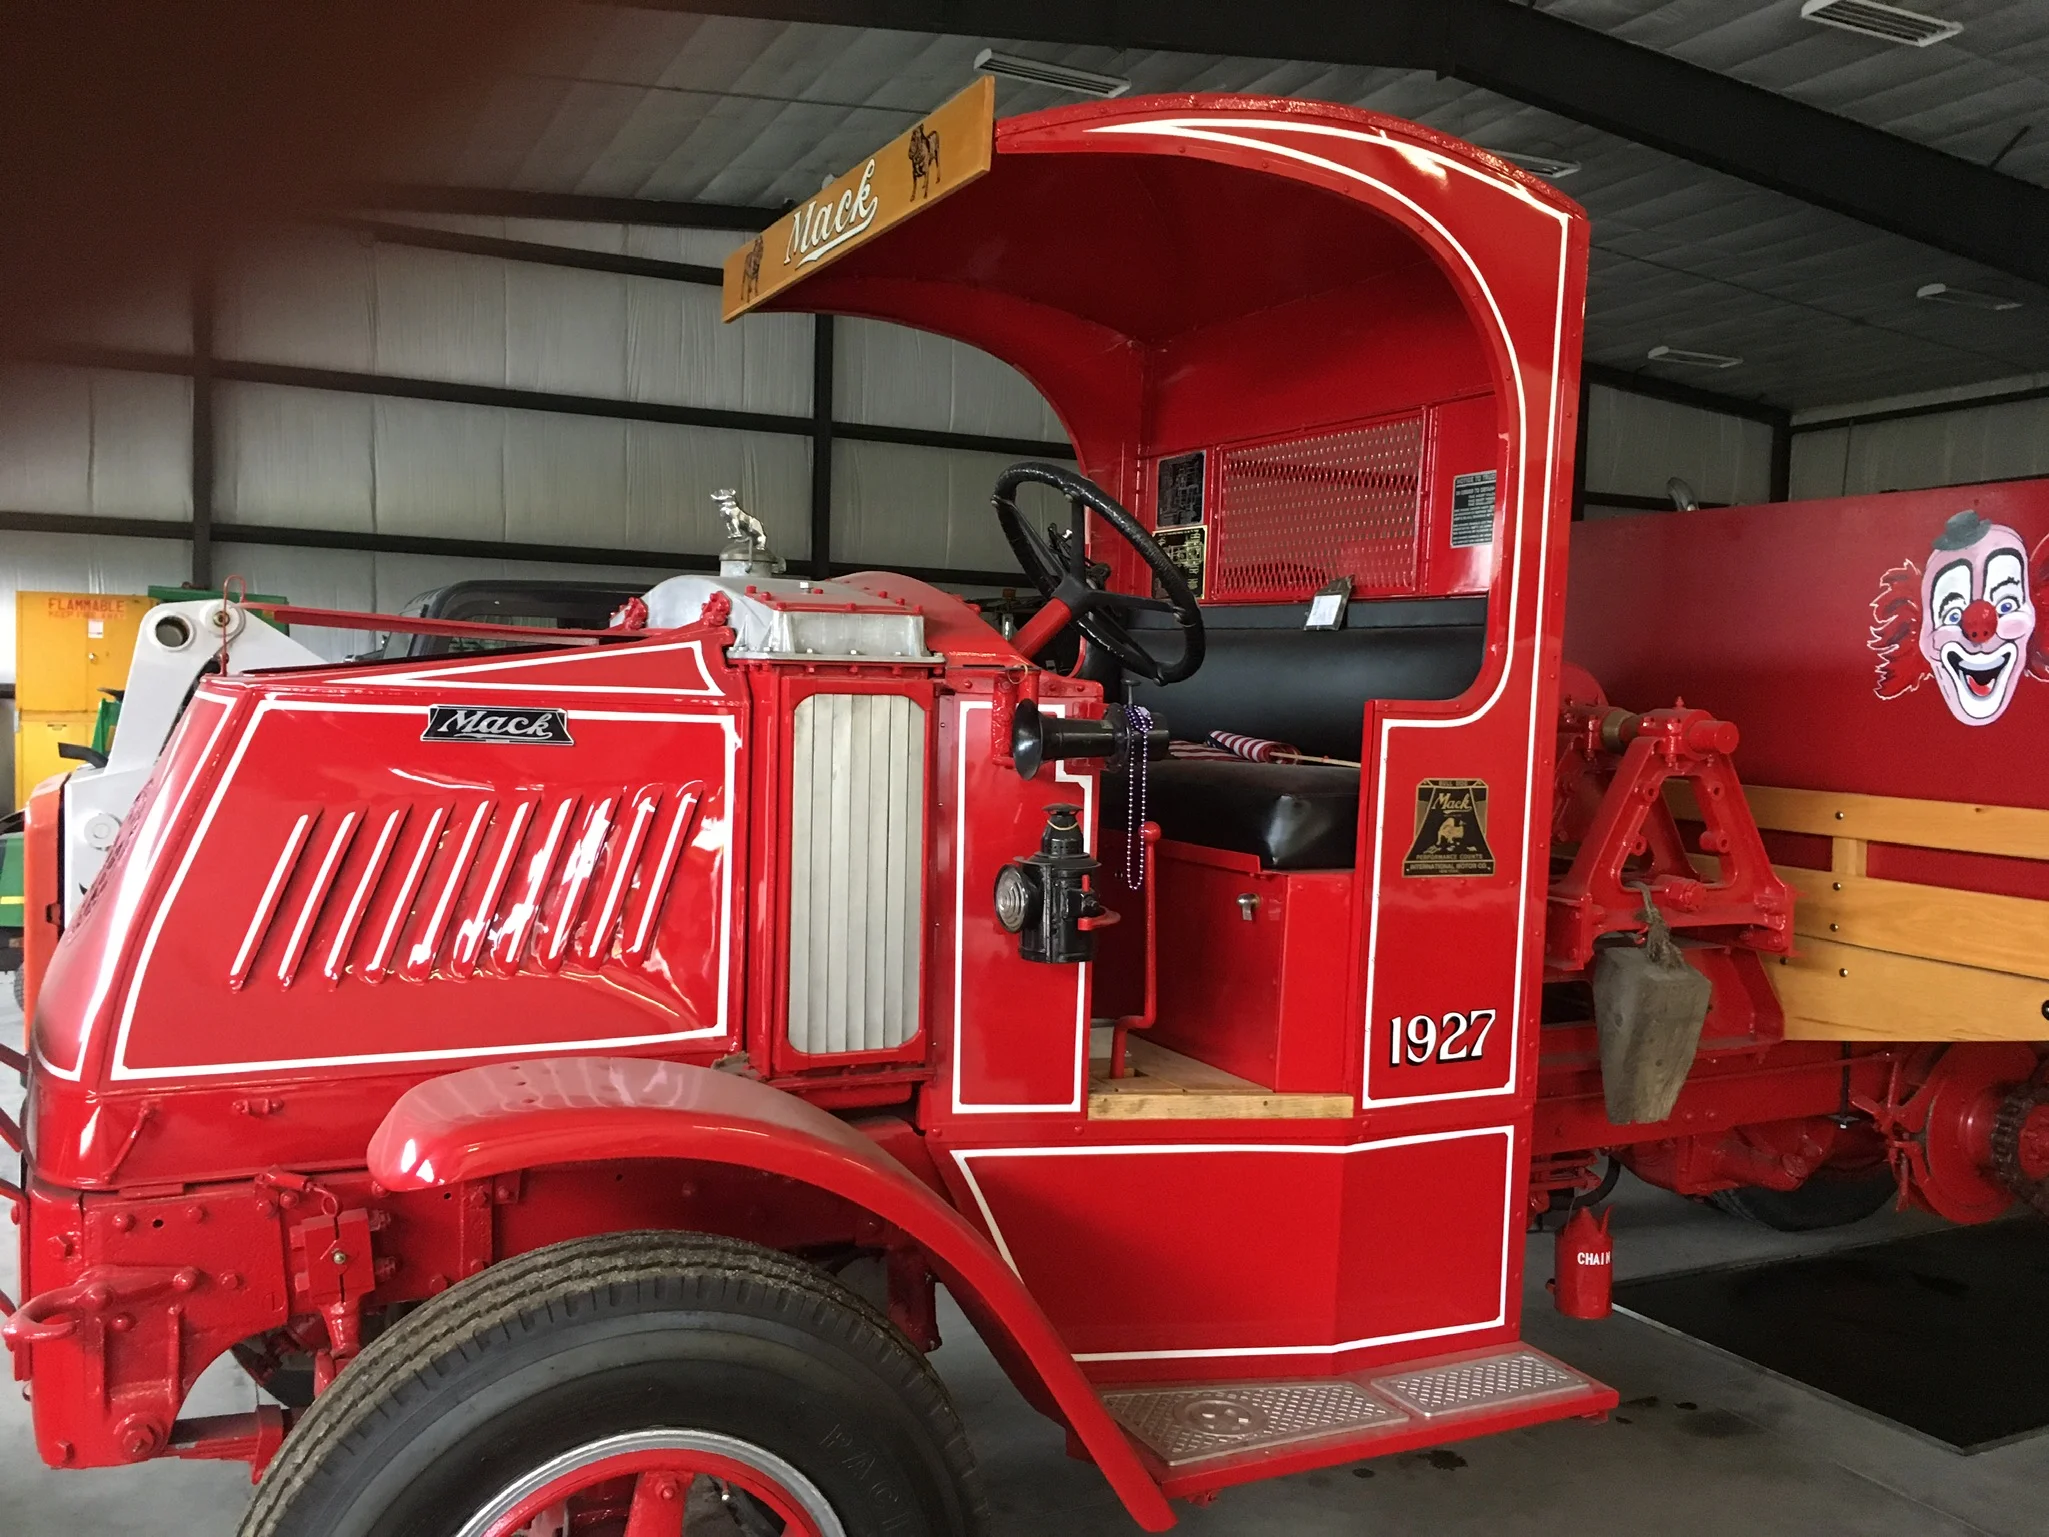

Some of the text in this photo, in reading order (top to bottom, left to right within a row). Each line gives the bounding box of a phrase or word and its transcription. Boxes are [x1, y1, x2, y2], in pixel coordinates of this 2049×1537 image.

[783, 158, 879, 271] Mack
[48, 597, 125, 613] FLAMMABLE
[437, 709, 553, 740] Mack
[1431, 793, 1472, 814] Mack
[1390, 1009, 1496, 1068] 1927
[1576, 1250, 1612, 1266] CHAIN
